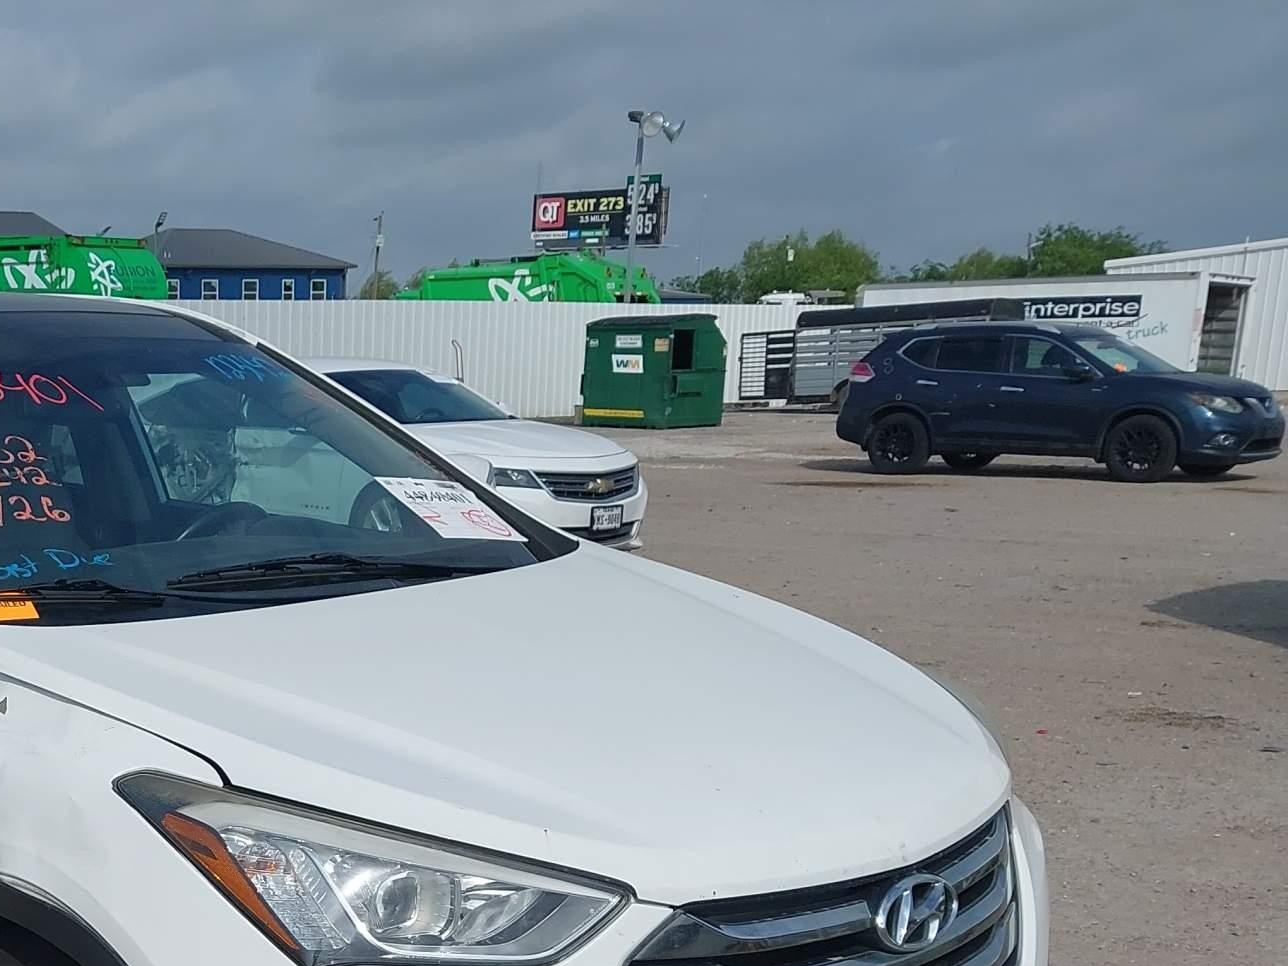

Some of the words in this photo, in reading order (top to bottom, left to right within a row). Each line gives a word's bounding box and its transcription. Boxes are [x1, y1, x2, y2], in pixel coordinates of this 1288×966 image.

[538, 202, 560, 222] QT
[567, 198, 597, 213] EXIT
[599, 196, 624, 211] 273
[1126, 321, 1168, 340] truck
[616, 359, 640, 369] WM
[43, 548, 113, 570] Due
